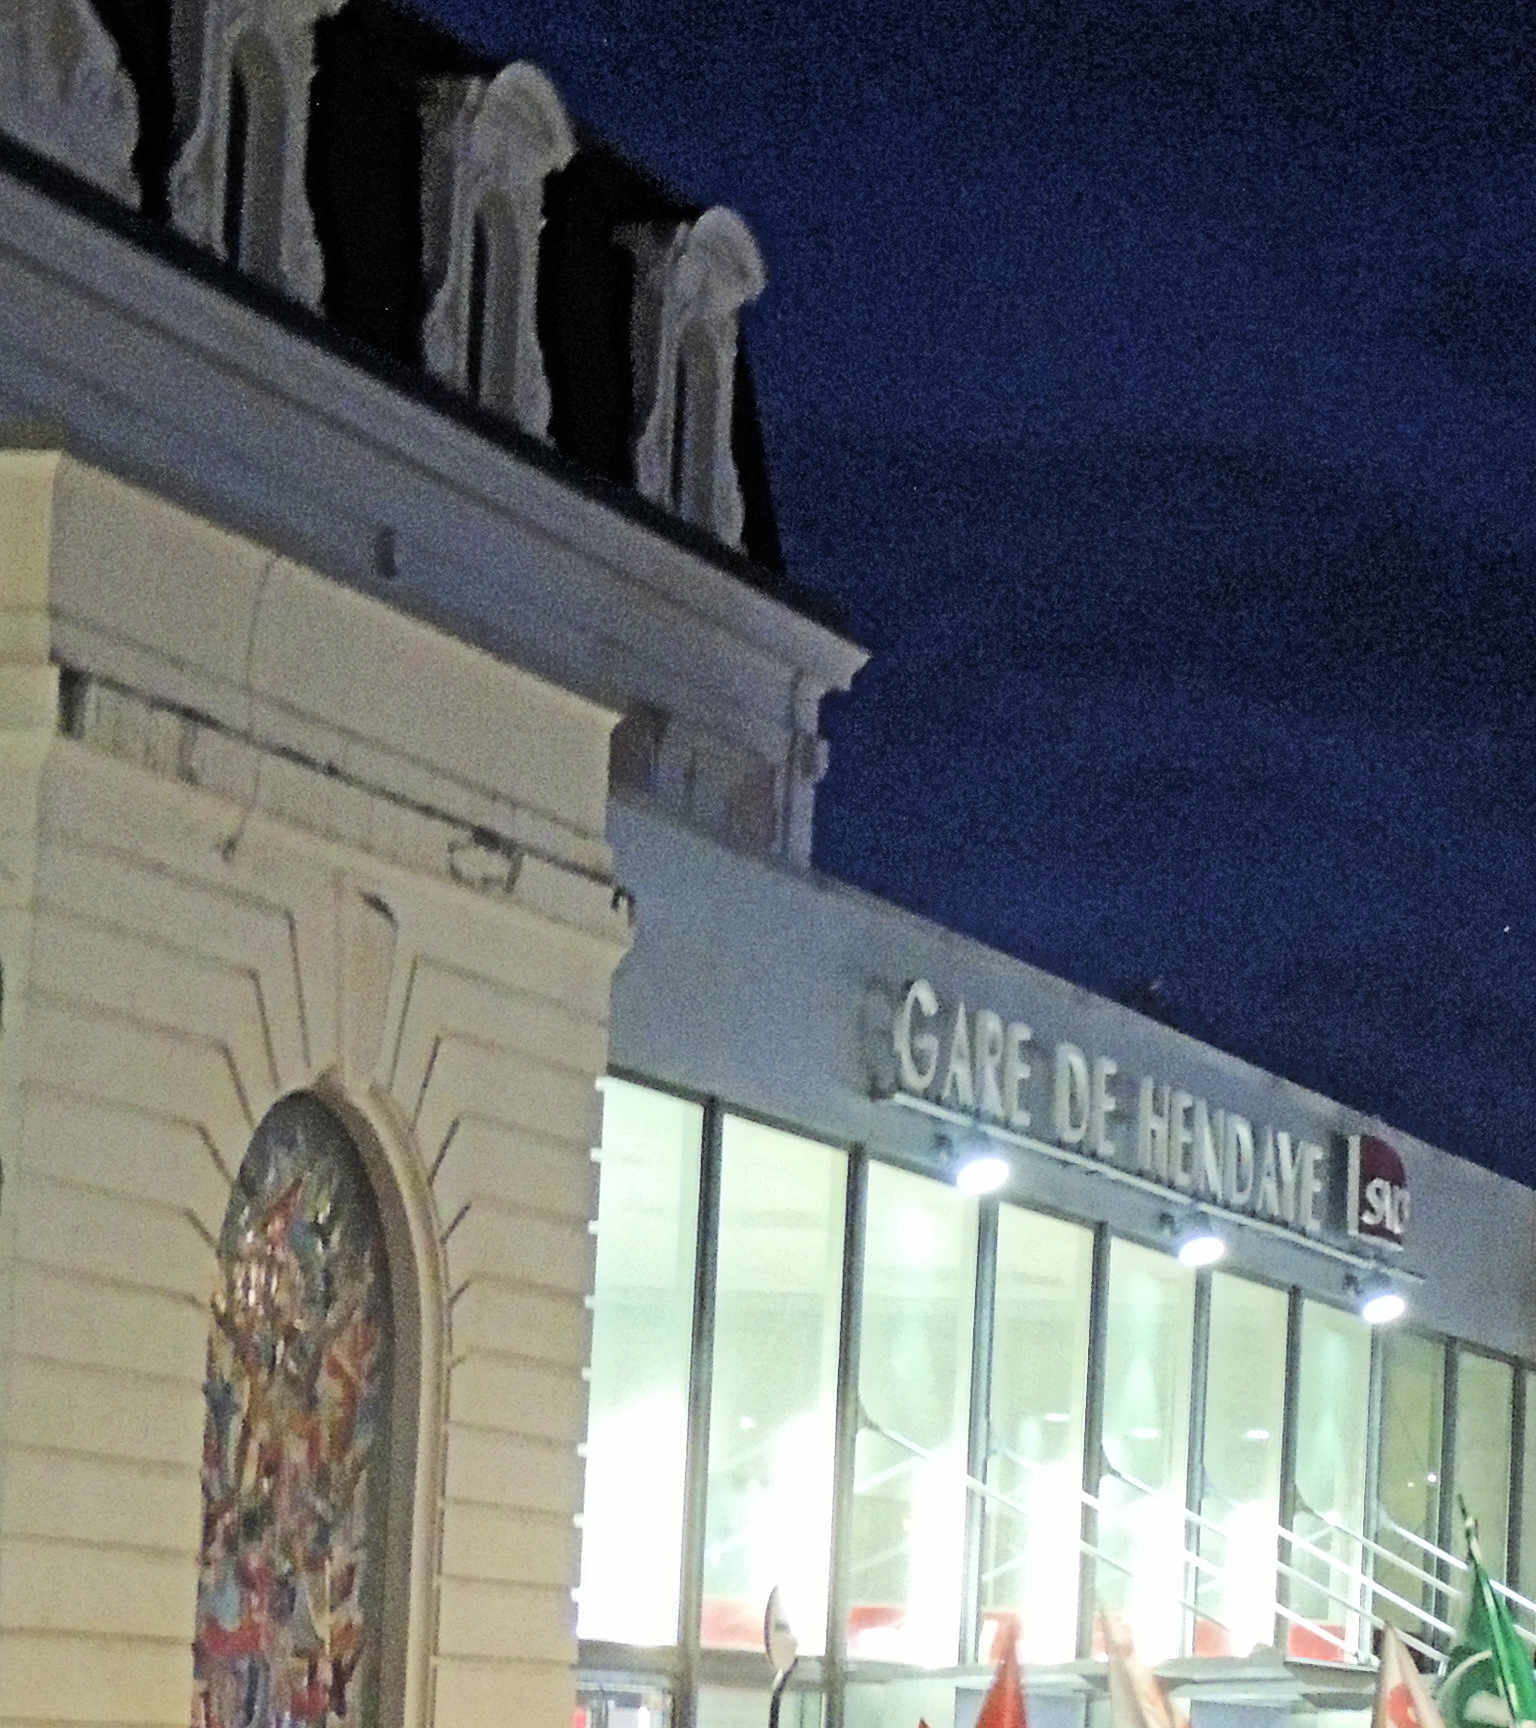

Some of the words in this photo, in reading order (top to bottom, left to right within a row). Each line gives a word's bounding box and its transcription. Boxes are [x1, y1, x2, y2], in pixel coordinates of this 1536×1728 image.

[893, 978, 1033, 1127] GARE
[1055, 1042, 1118, 1157] DE
[1138, 1074, 1324, 1232] HENDAYE
